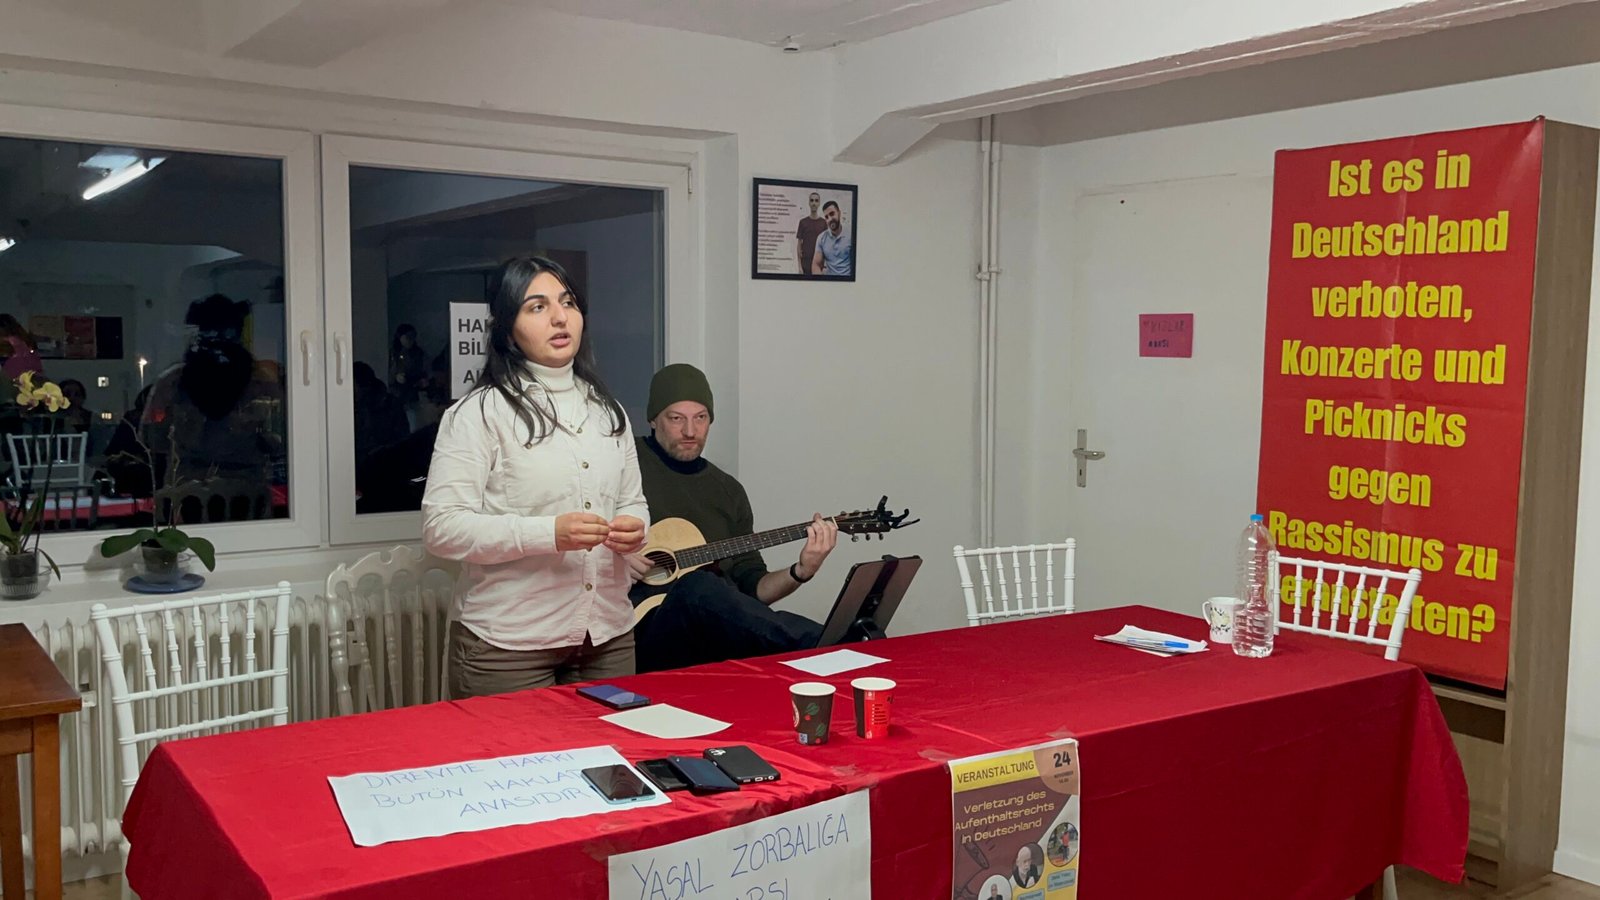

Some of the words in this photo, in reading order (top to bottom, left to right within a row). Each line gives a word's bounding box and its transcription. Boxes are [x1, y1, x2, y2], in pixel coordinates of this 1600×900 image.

[1328, 158, 1372, 197] Ist
[1382, 157, 1424, 193] es
[1435, 149, 1471, 189] in
[1291, 210, 1510, 259] Deutschland
[1311, 280, 1473, 323] verboten,
[1280, 339, 1422, 382] Konzerte
[1433, 344, 1506, 385] und
[1304, 398, 1468, 448] Picknicks
[1328, 464, 1432, 508] gegen
[1269, 510, 1445, 572] Rassismus
[1454, 543, 1499, 581] zu
[1276, 573, 1496, 644] eranstaten?
[498, 753, 575, 769] HAKKI
[957, 760, 1034, 783] VERANSTALTUNG
[1053, 751, 1071, 768] 24
[459, 787, 591, 818] ANASIDIR
[954, 802, 1055, 832] Aufenthaltsrechts
[963, 795, 1024, 815] Verletzung
[1026, 791, 1046, 801] des
[974, 817, 1042, 842] Deutschland
